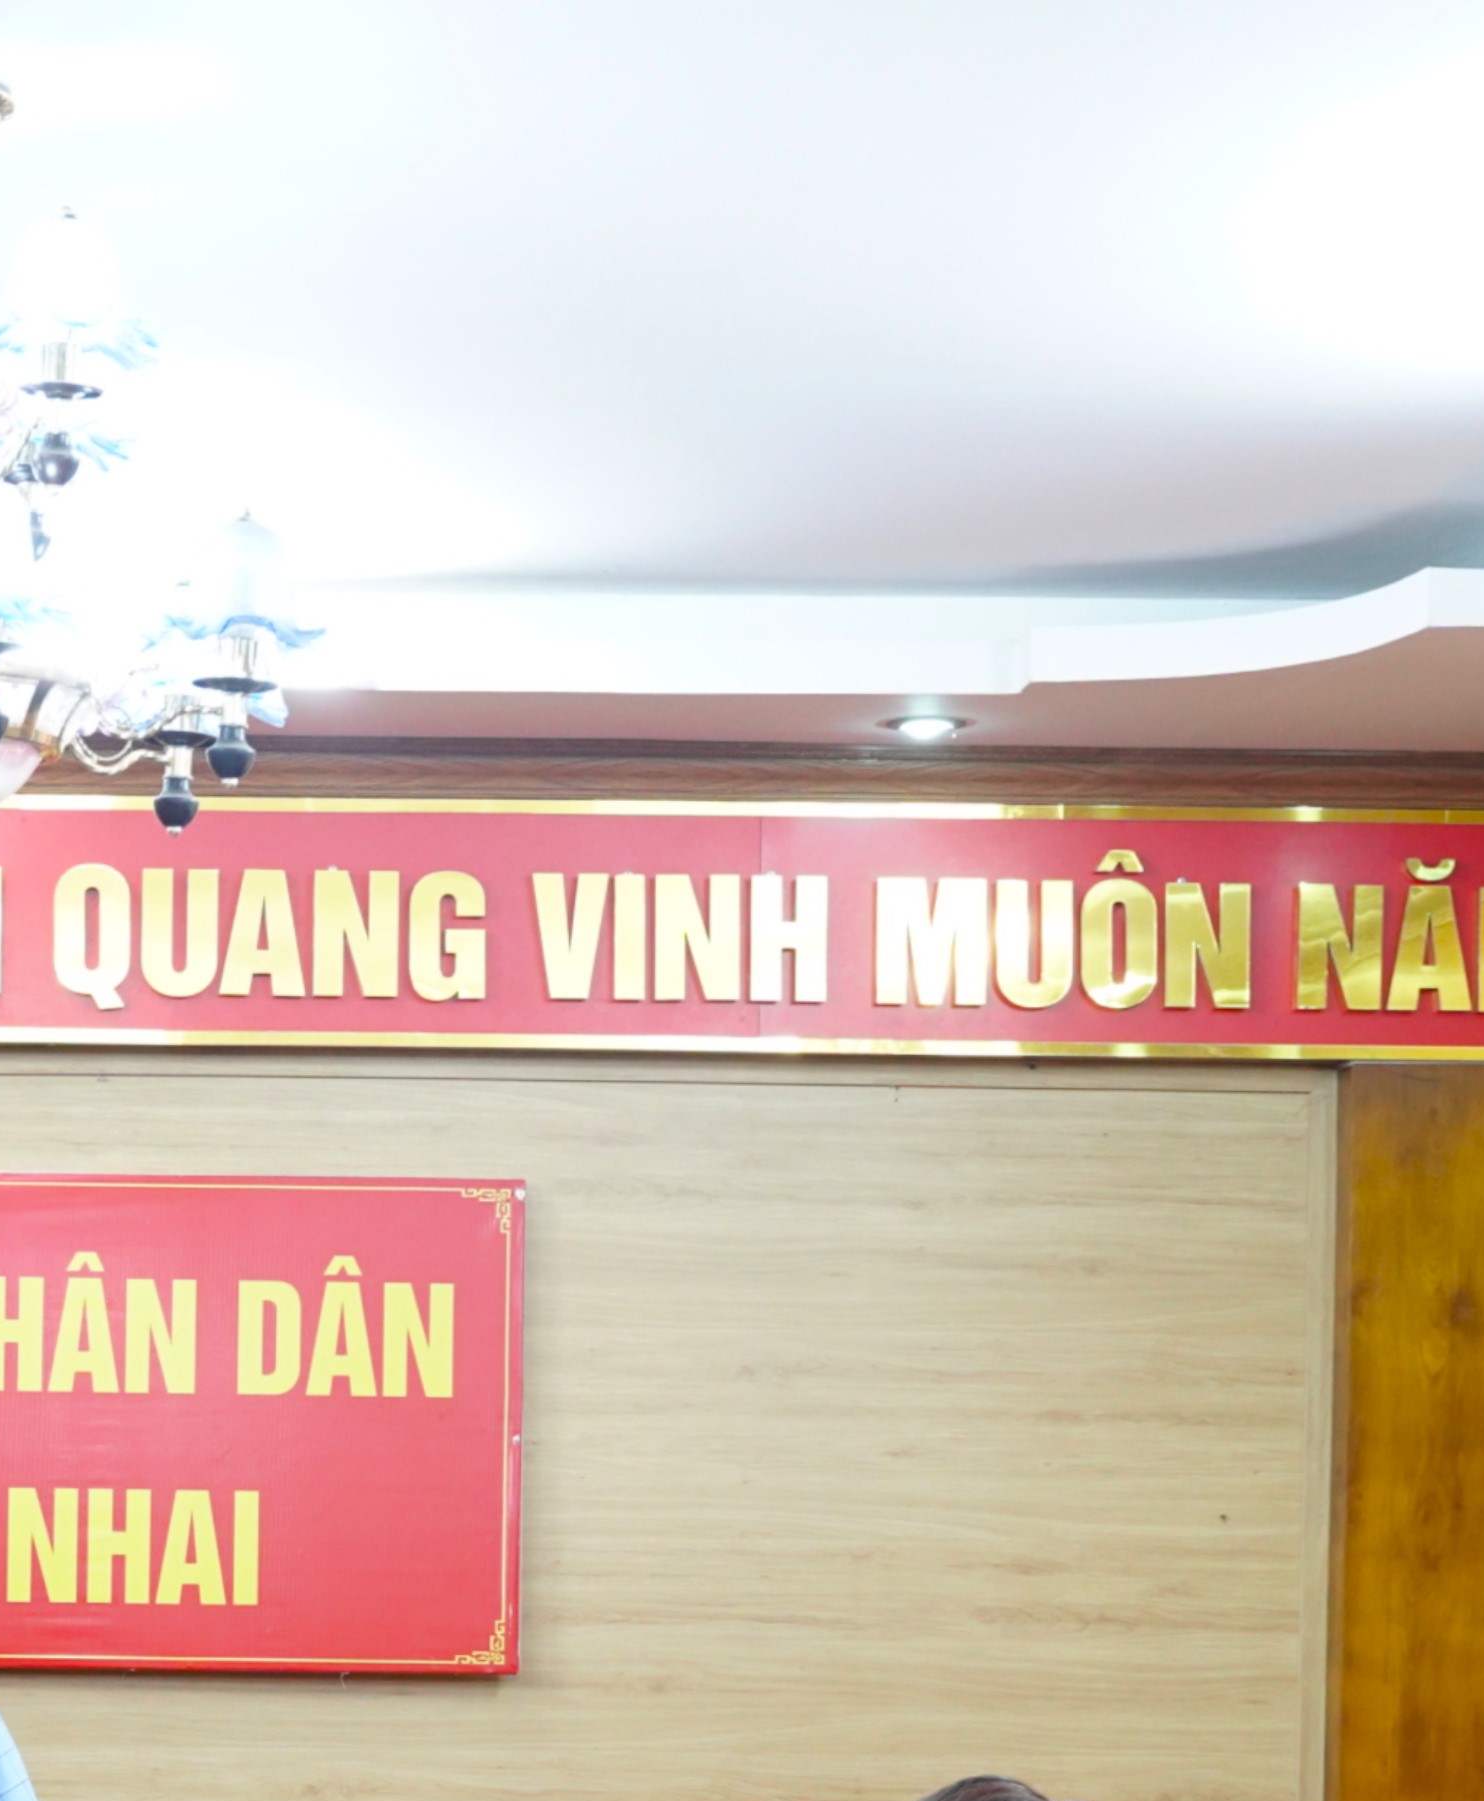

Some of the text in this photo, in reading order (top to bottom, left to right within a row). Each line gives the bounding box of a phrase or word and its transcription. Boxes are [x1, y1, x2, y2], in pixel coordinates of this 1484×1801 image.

[50, 860, 490, 1013] QUANG
[531, 868, 830, 1005] VINH
[872, 848, 1253, 1012] MUÔN
[236, 1254, 456, 1399] DÂN
[5, 1486, 261, 1606] NHAI
